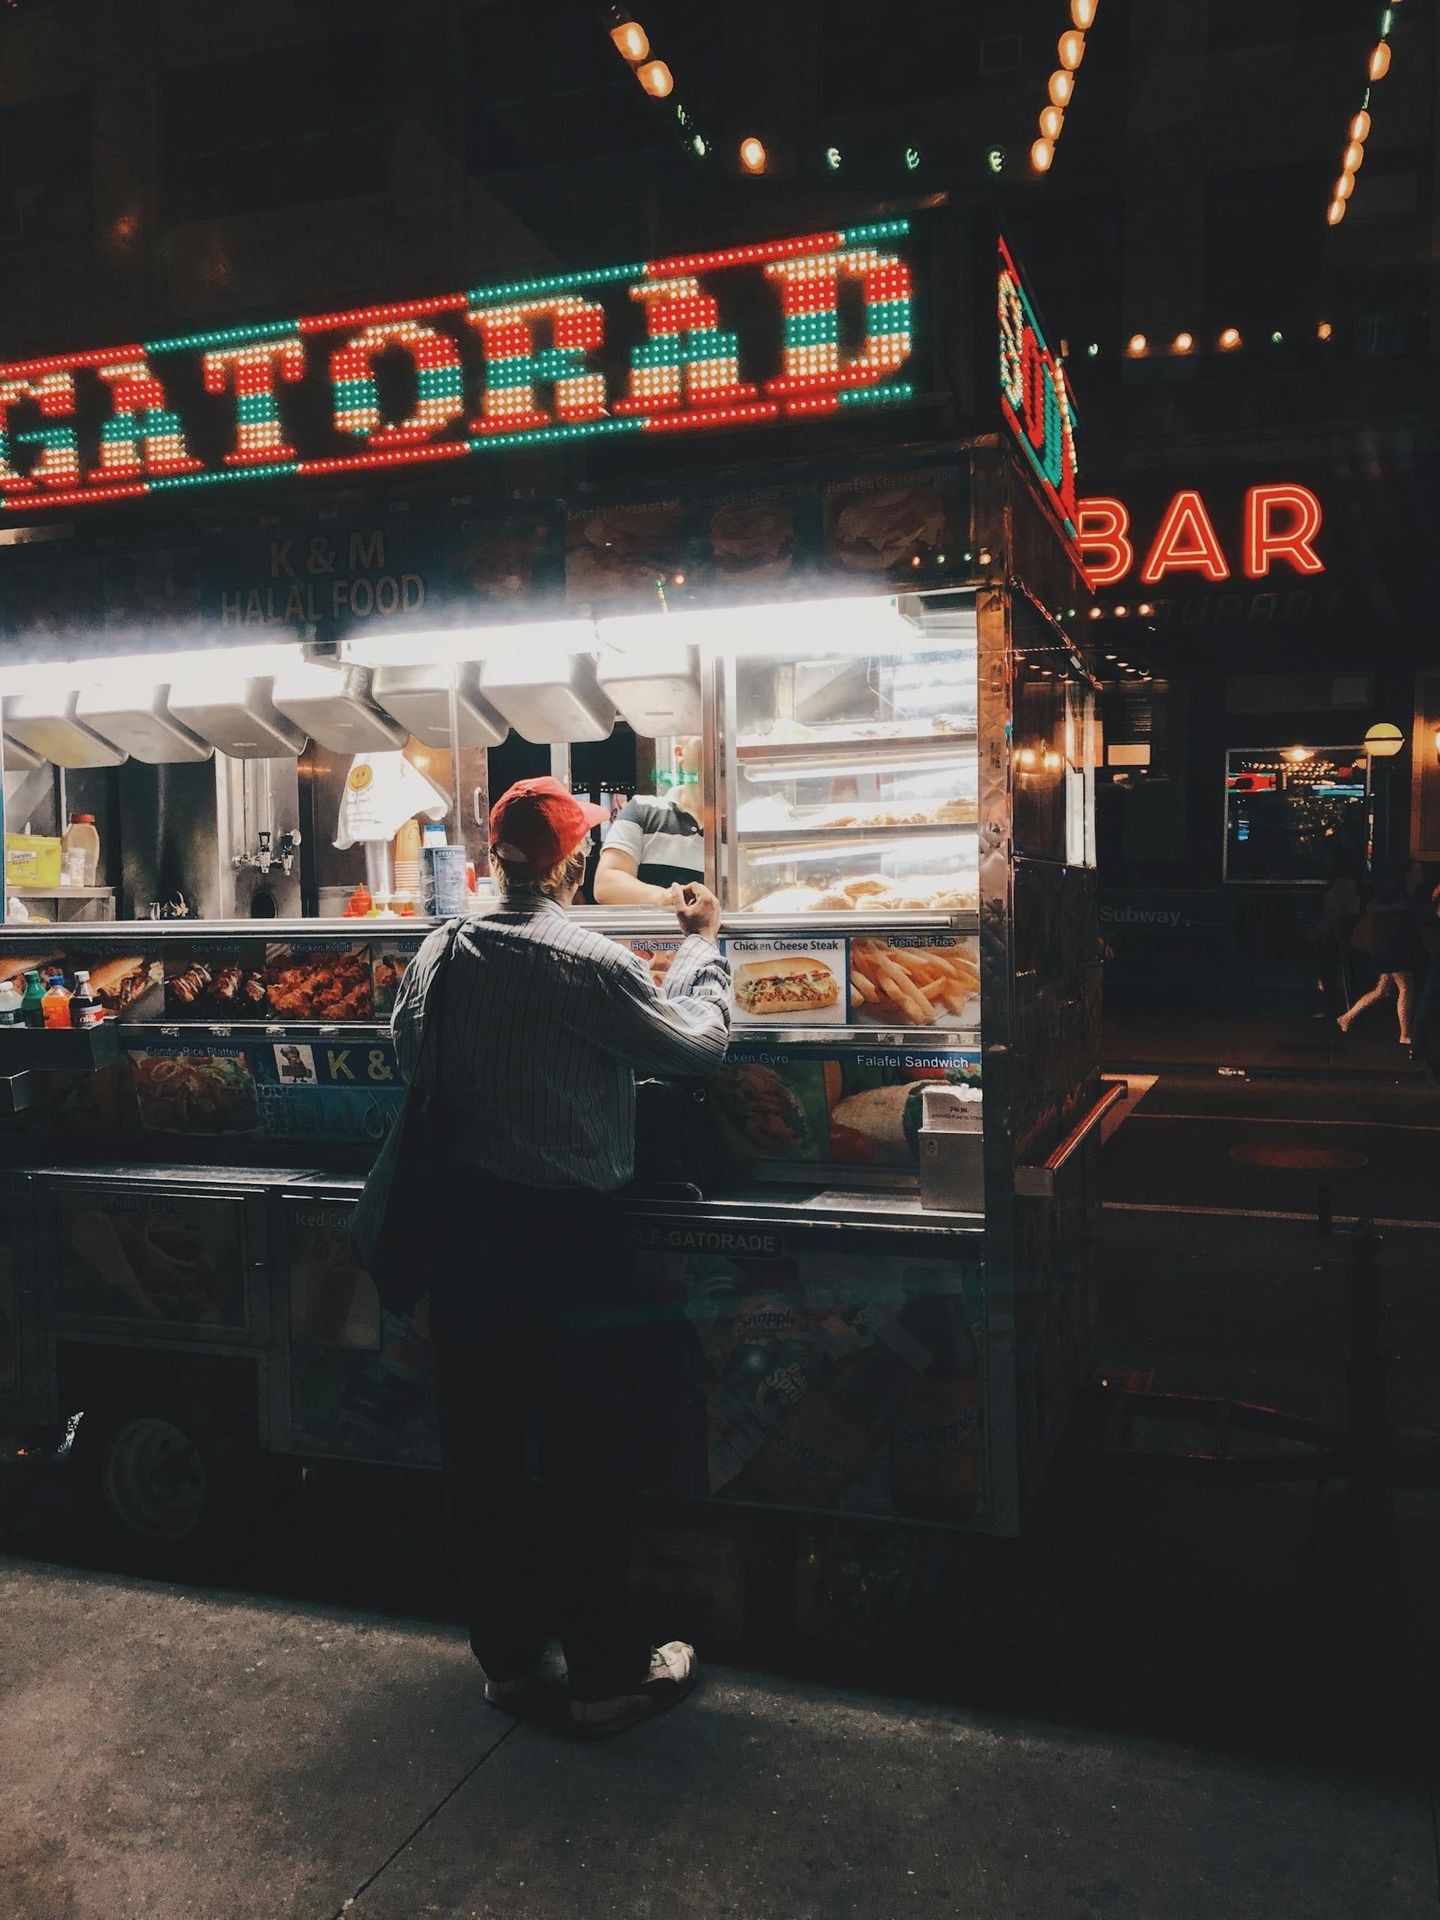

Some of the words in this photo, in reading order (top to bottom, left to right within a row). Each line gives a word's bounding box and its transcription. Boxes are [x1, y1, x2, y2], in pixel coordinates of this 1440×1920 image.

[1077, 484, 1326, 585] BAR
[270, 539, 296, 577] K
[307, 535, 336, 575] &
[349, 529, 384, 570] M
[222, 581, 324, 626] HALAL
[333, 573, 426, 618] FOOD
[631, 941, 650, 951] Hot
[733, 941, 771, 951] Chicken
[774, 940, 810, 951] Cheese
[811, 941, 839, 951] Steak
[888, 938, 925, 948] French
[928, 937, 956, 947] Fries
[146, 1045, 180, 1057] Combo
[182, 1046, 205, 1056] Rice
[207, 1046, 241, 1057] Platter
[326, 1050, 357, 1080] K
[367, 1049, 394, 1081] &
[720, 1053, 756, 1065] icken
[759, 1053, 789, 1066] Gyro
[857, 1055, 900, 1068] Falafel
[905, 1056, 969, 1069] Sandwich
[295, 1211, 325, 1226] Iced
[626, 1229, 776, 1252] PLE-GATORADE
